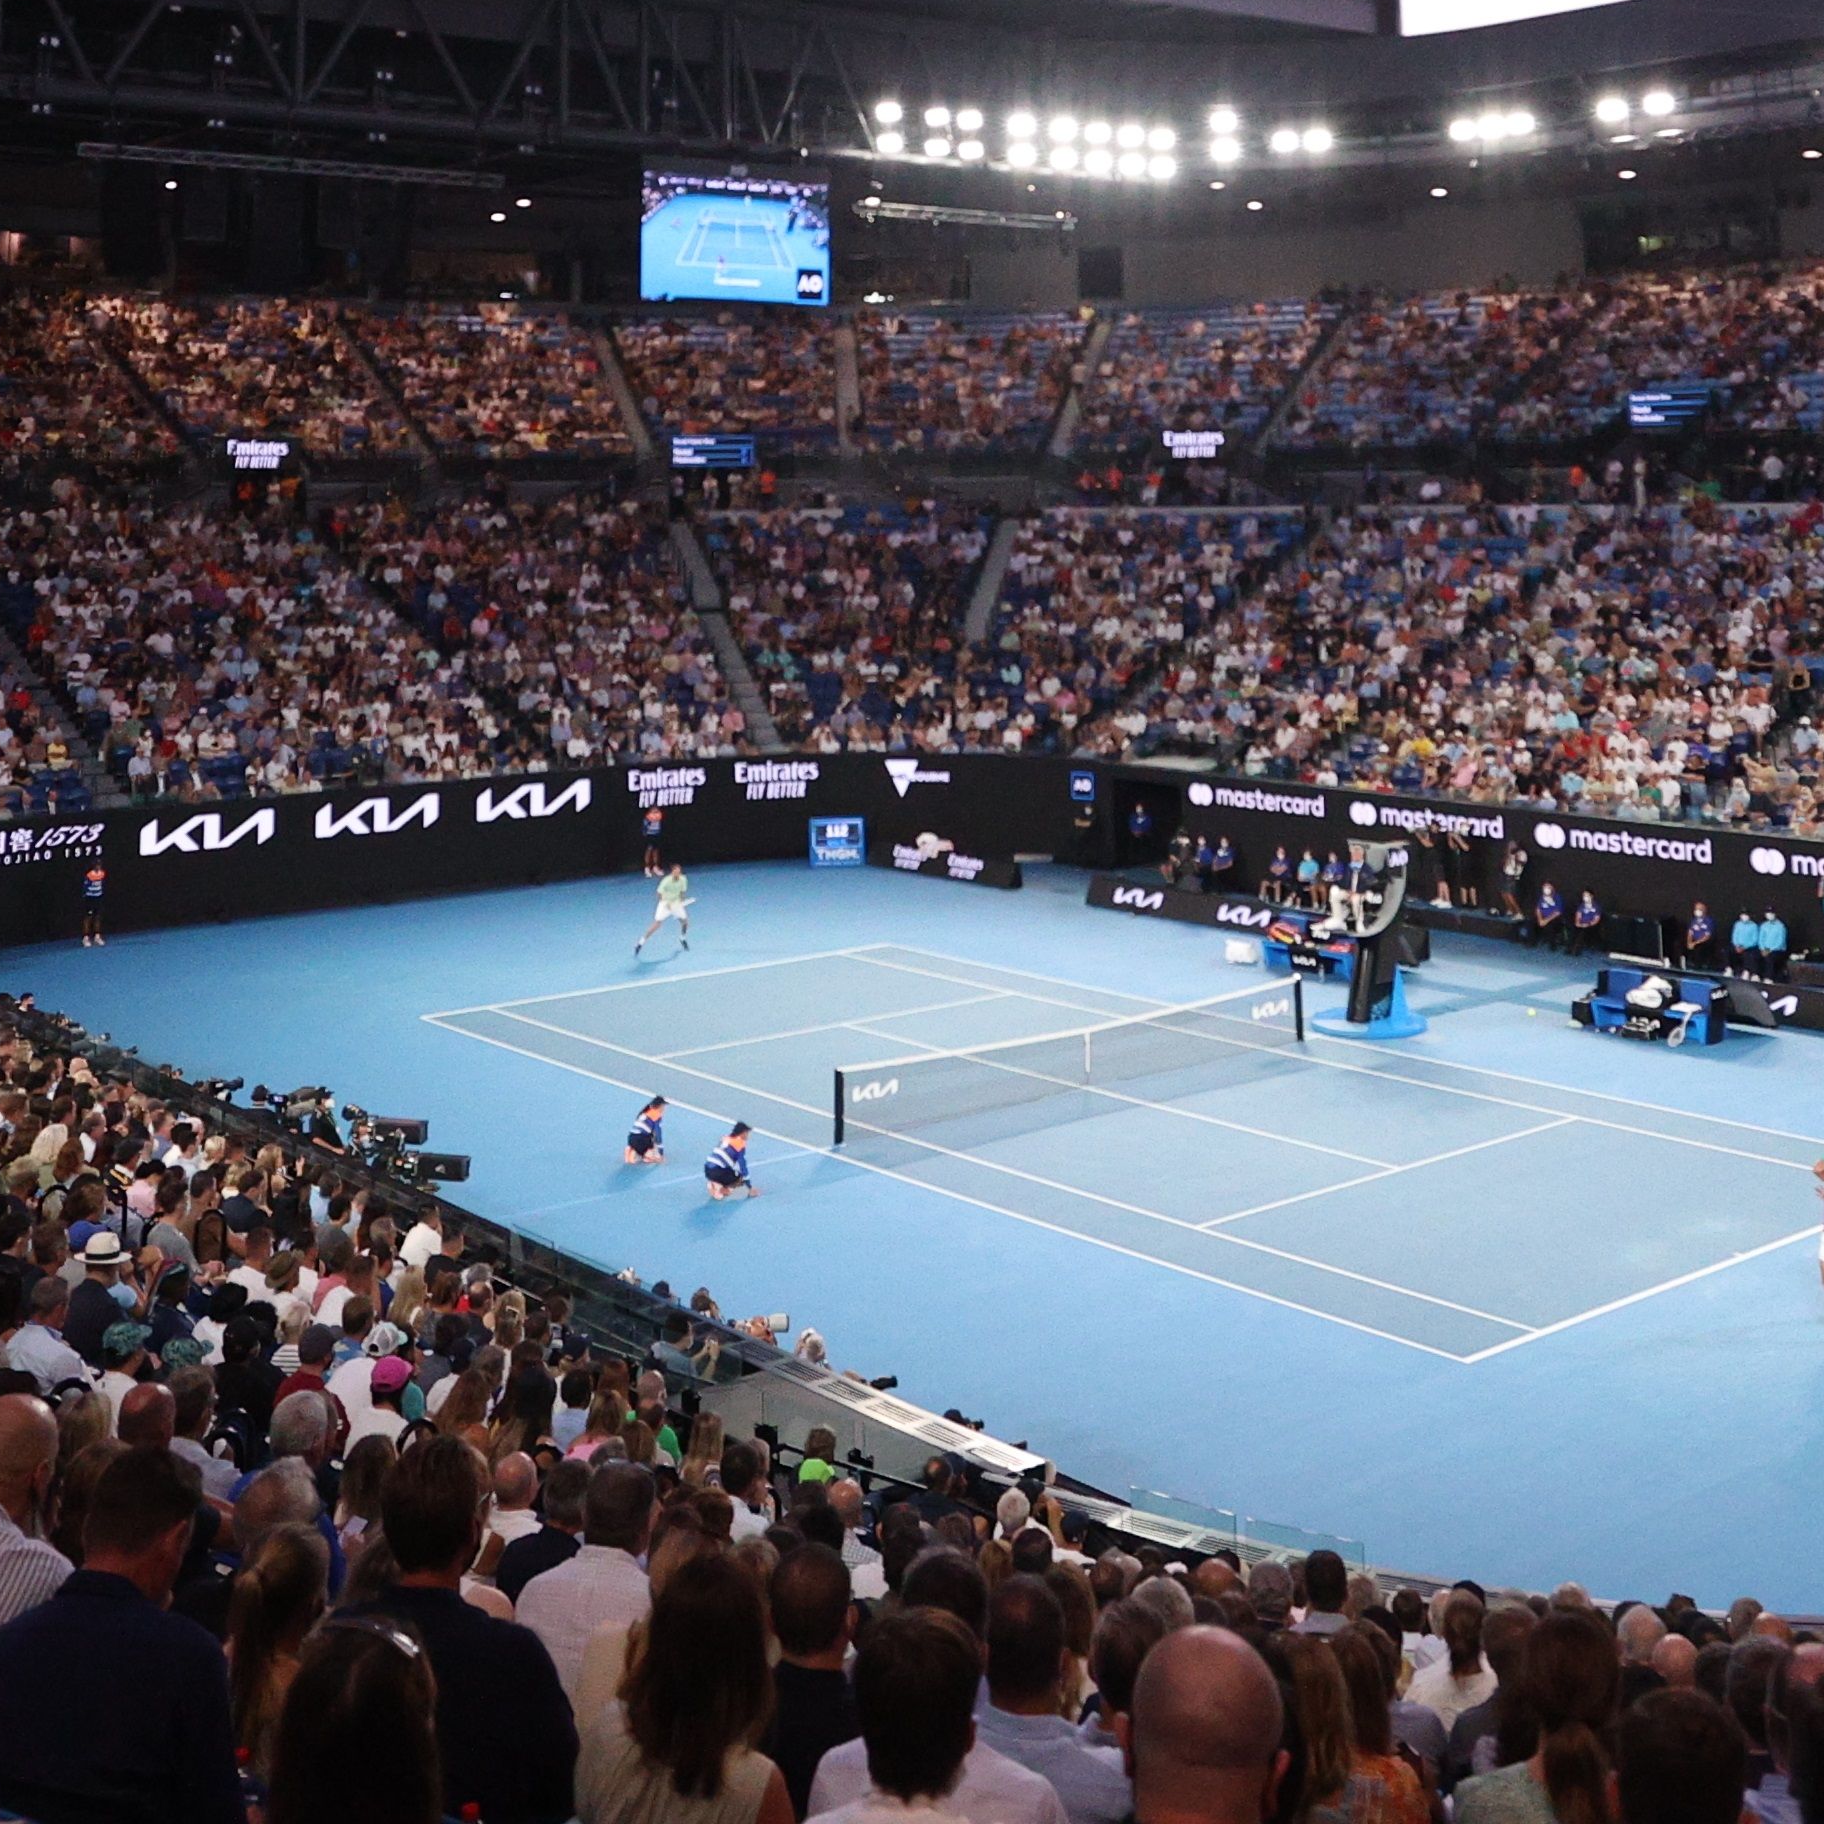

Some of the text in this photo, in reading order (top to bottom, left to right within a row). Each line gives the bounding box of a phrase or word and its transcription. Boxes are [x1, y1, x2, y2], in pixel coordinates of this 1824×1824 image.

[797, 275, 824, 293] AO
[627, 766, 706, 792] Emirates
[734, 760, 819, 784] Emirates
[639, 787, 694, 808] FLY BETTER
[746, 780, 807, 800] FLY BETTER
[1216, 786, 1325, 818] mastercard
[65, 845, 103, 859] 1573
[1570, 827, 1712, 864] mastercard
